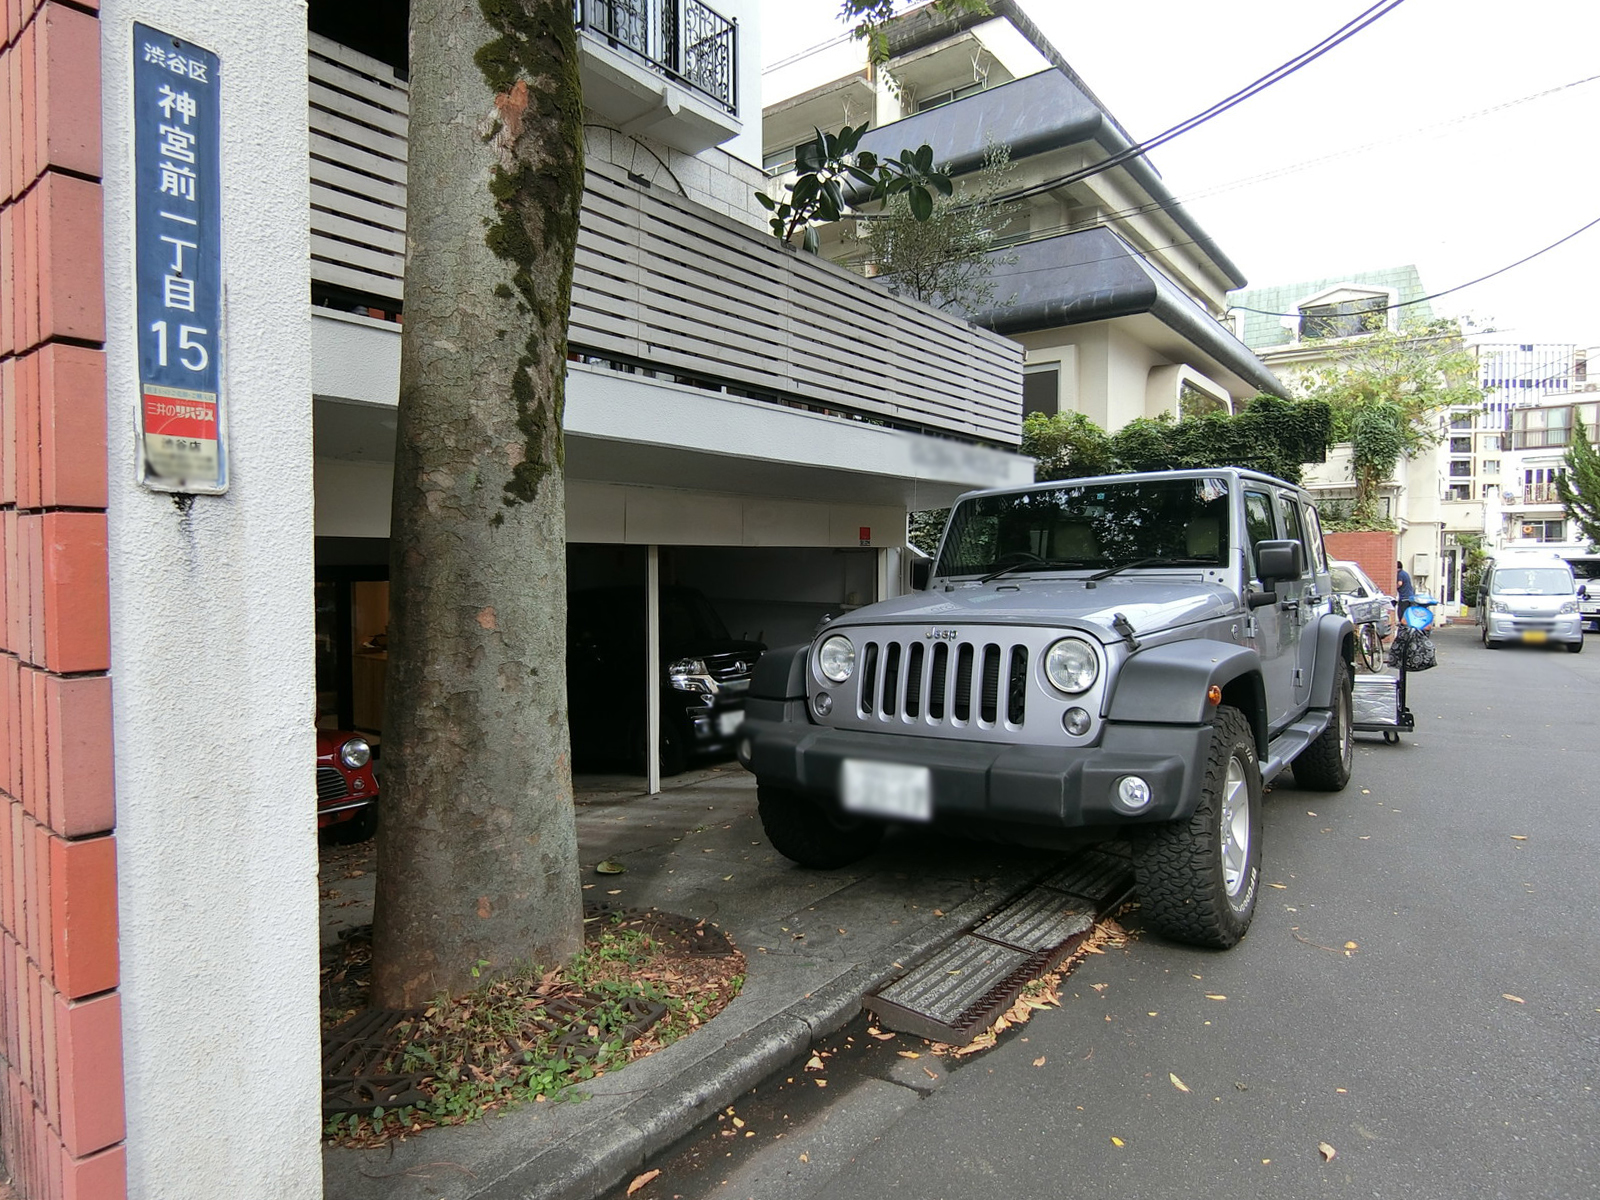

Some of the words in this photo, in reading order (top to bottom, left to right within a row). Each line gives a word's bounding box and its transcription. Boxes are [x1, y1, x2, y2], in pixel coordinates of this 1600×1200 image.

[144, 43, 208, 83] 渋谷区
[158, 85, 198, 312] 神宮前一丁目
[151, 320, 209, 371] 15
[925, 626, 958, 642] Jeep
